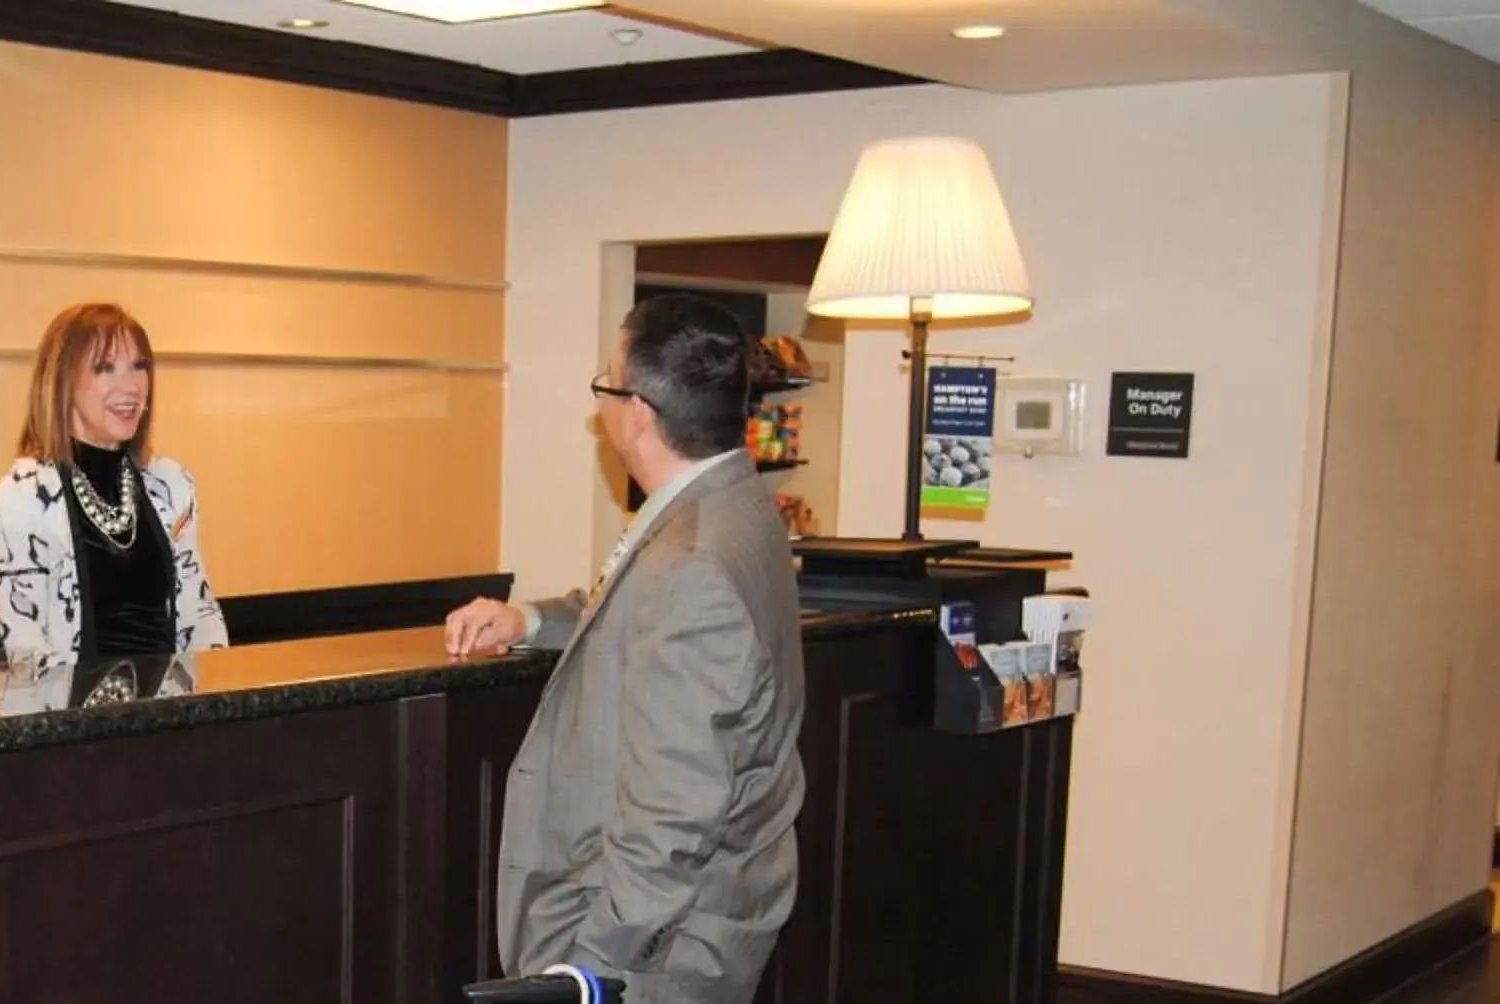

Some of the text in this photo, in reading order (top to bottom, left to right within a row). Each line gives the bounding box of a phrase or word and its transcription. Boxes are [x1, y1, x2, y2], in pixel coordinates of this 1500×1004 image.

[1127, 388, 1184, 404] Manager
[1128, 402, 1184, 419] On Duty
